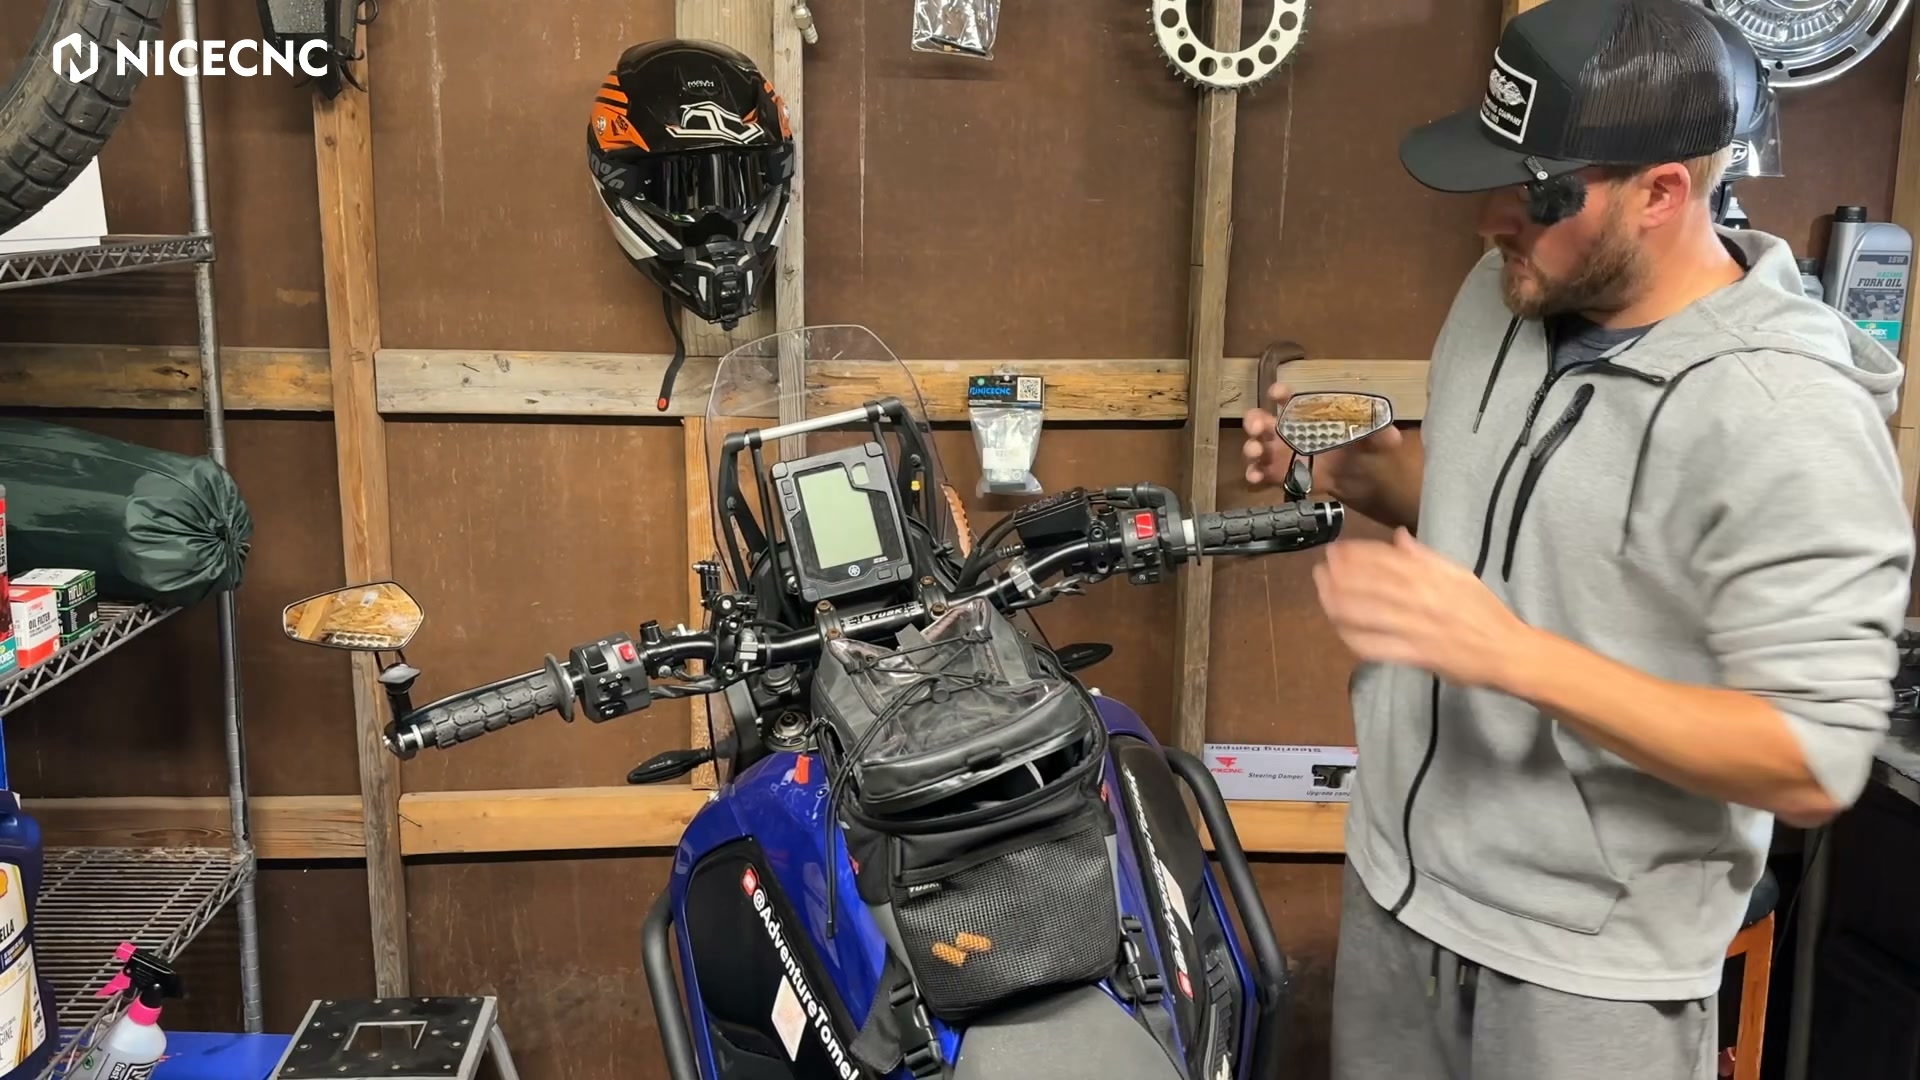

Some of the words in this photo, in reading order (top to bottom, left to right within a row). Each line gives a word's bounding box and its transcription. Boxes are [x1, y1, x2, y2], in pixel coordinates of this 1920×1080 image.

[1857, 278, 1884, 287] FORK
[1885, 278, 1903, 287] OIL
[871, 607, 903, 620] TUSK
[29, 619, 37, 630] OIL
[37, 611, 51, 626] FILTER
[1248, 772, 1277, 780] Steering
[1278, 772, 1304, 781] Damper
